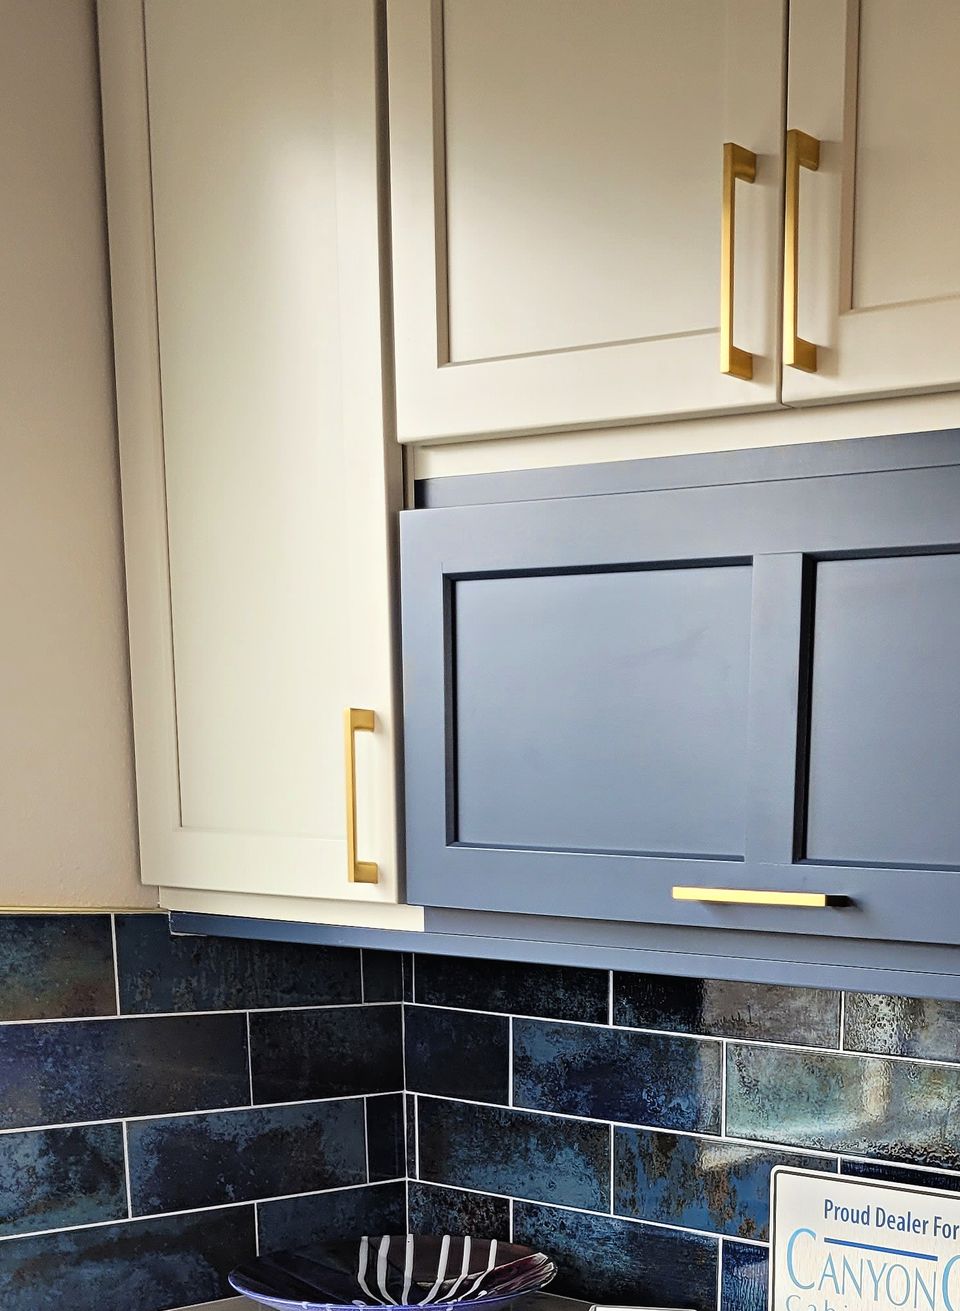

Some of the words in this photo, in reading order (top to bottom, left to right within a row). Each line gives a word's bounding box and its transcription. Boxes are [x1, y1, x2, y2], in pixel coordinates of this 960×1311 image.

[824, 1199, 870, 1226] Proud
[876, 1207, 929, 1235] Dealer
[933, 1216, 960, 1241] For
